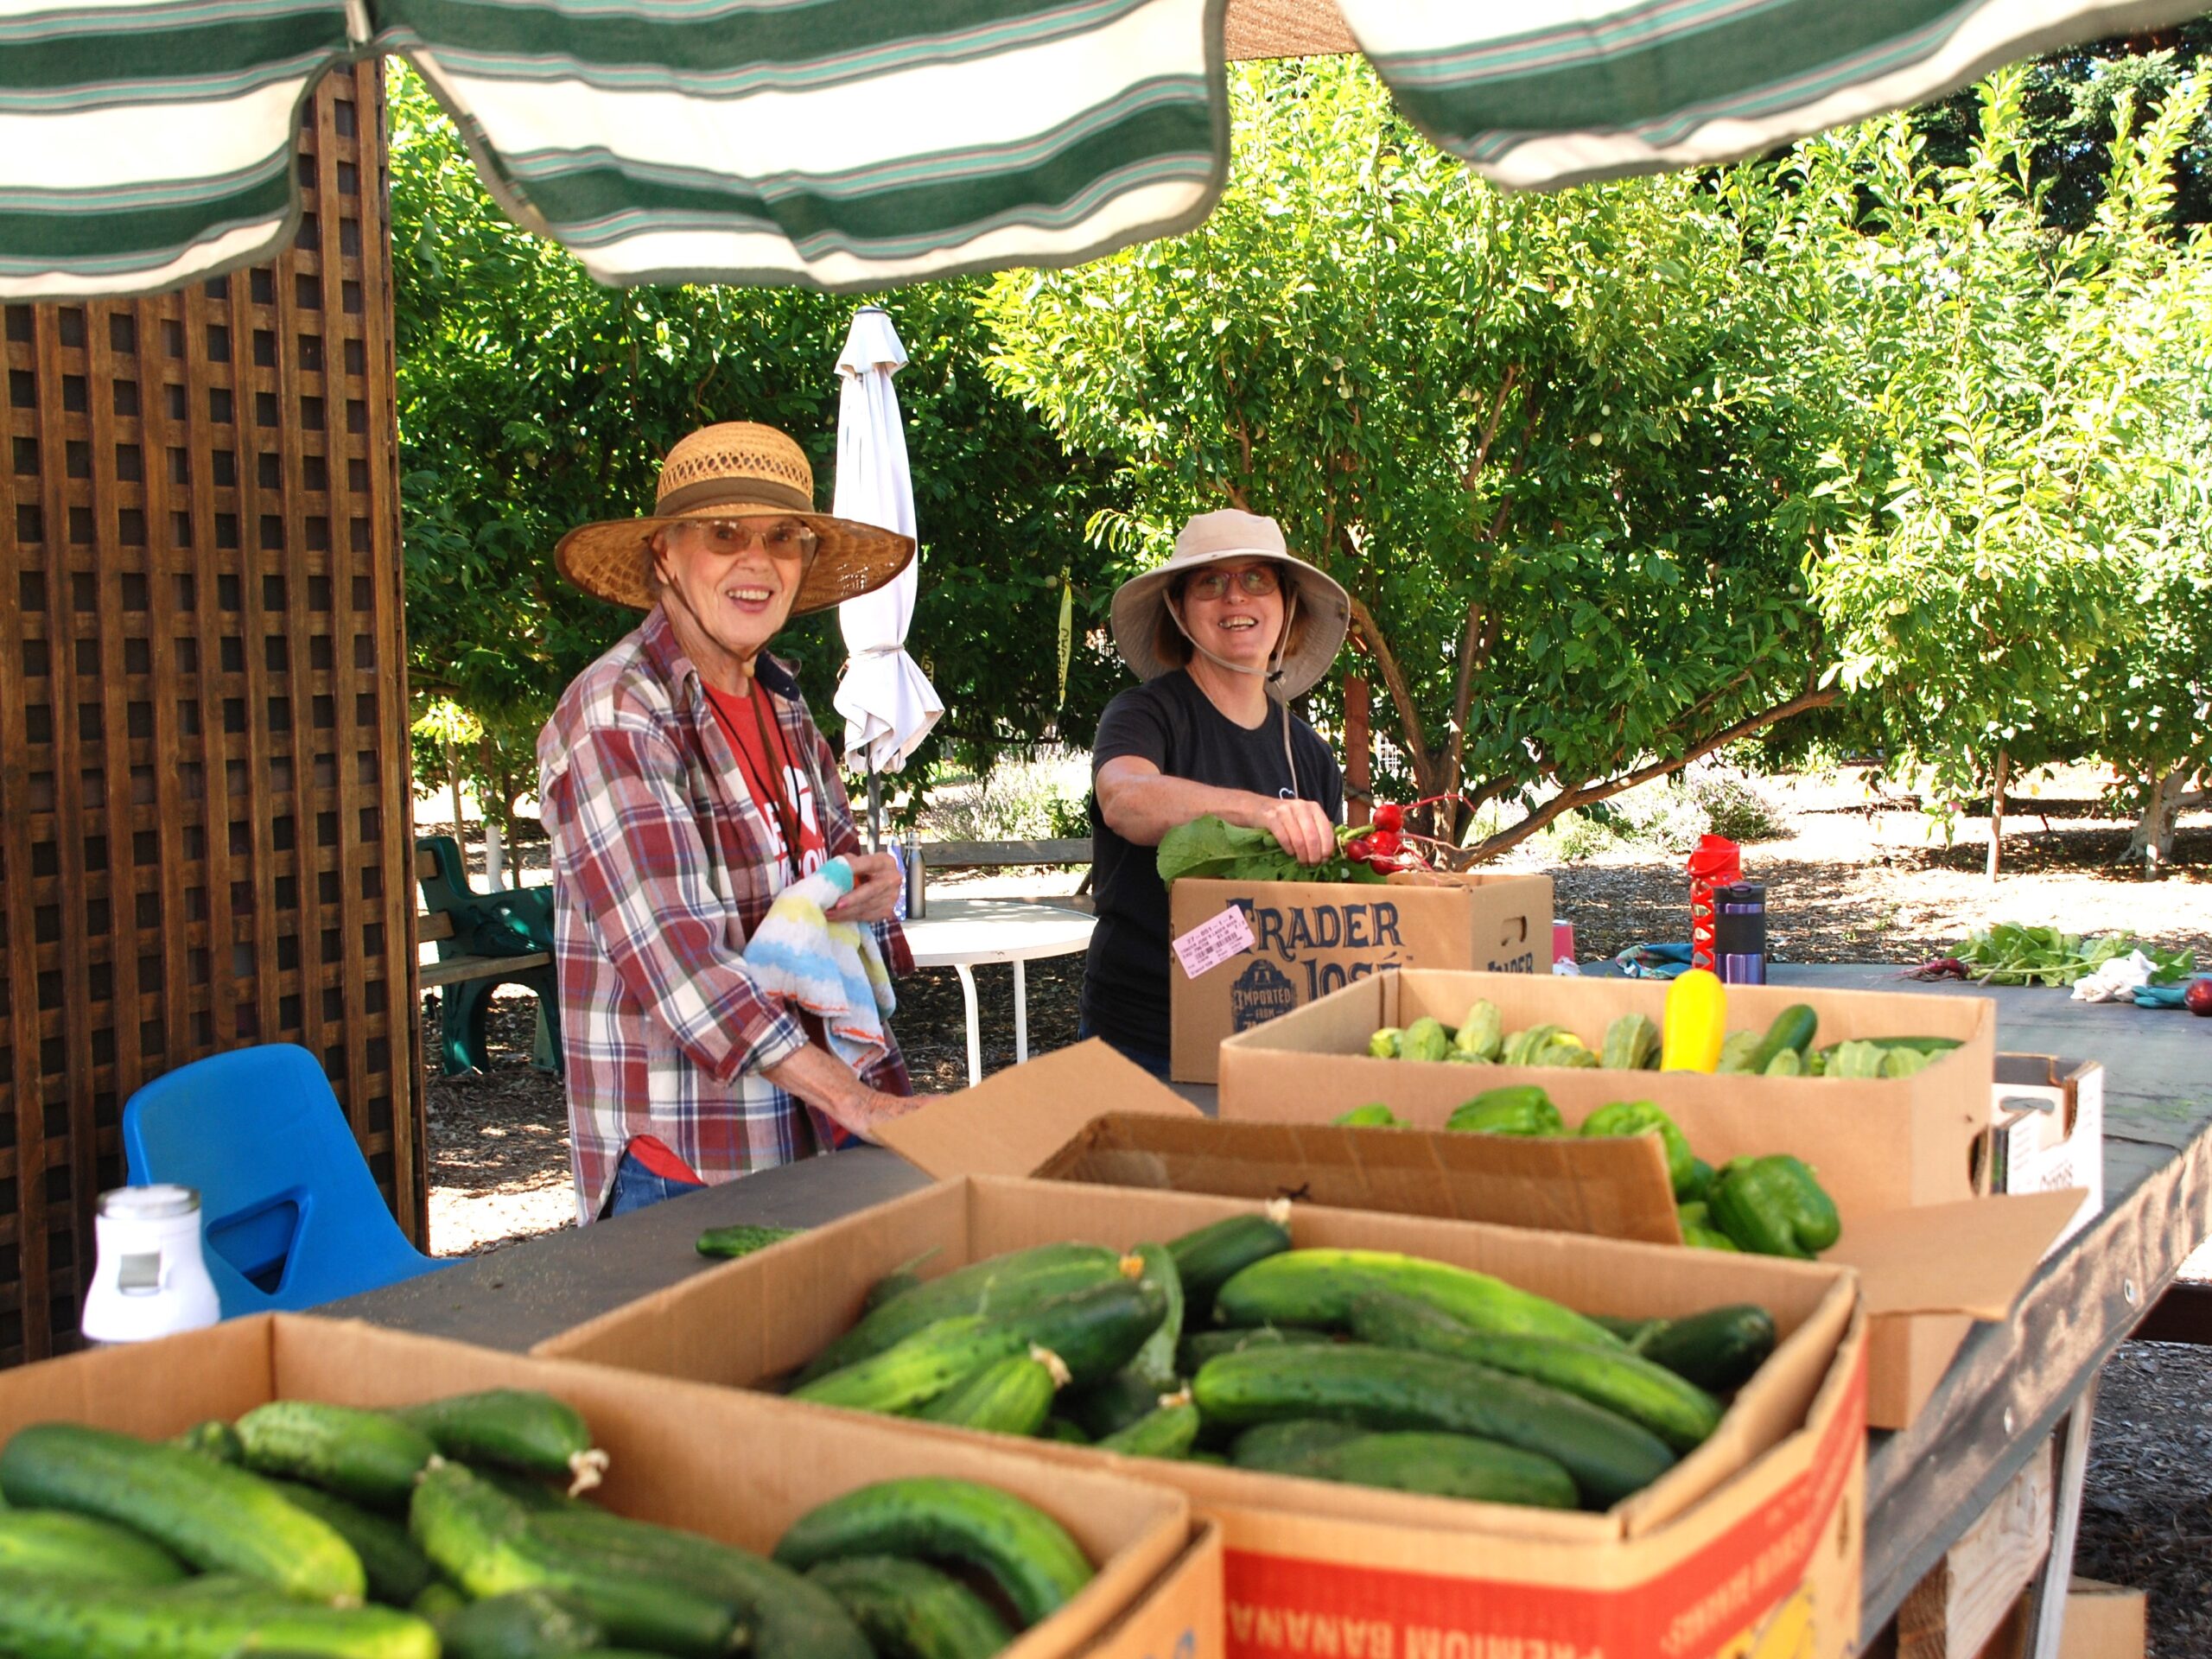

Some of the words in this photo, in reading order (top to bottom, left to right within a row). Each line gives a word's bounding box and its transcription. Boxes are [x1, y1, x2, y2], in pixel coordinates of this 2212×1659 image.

[1226, 898, 1405, 962] TRADER
[1300, 950, 1402, 1001] JOS
[1487, 952, 1533, 974] DER
[1234, 988, 1291, 1009] IMPORTED
[1255, 1007, 1275, 1019] FROM
[1402, 1624, 1605, 1659] MIUM
